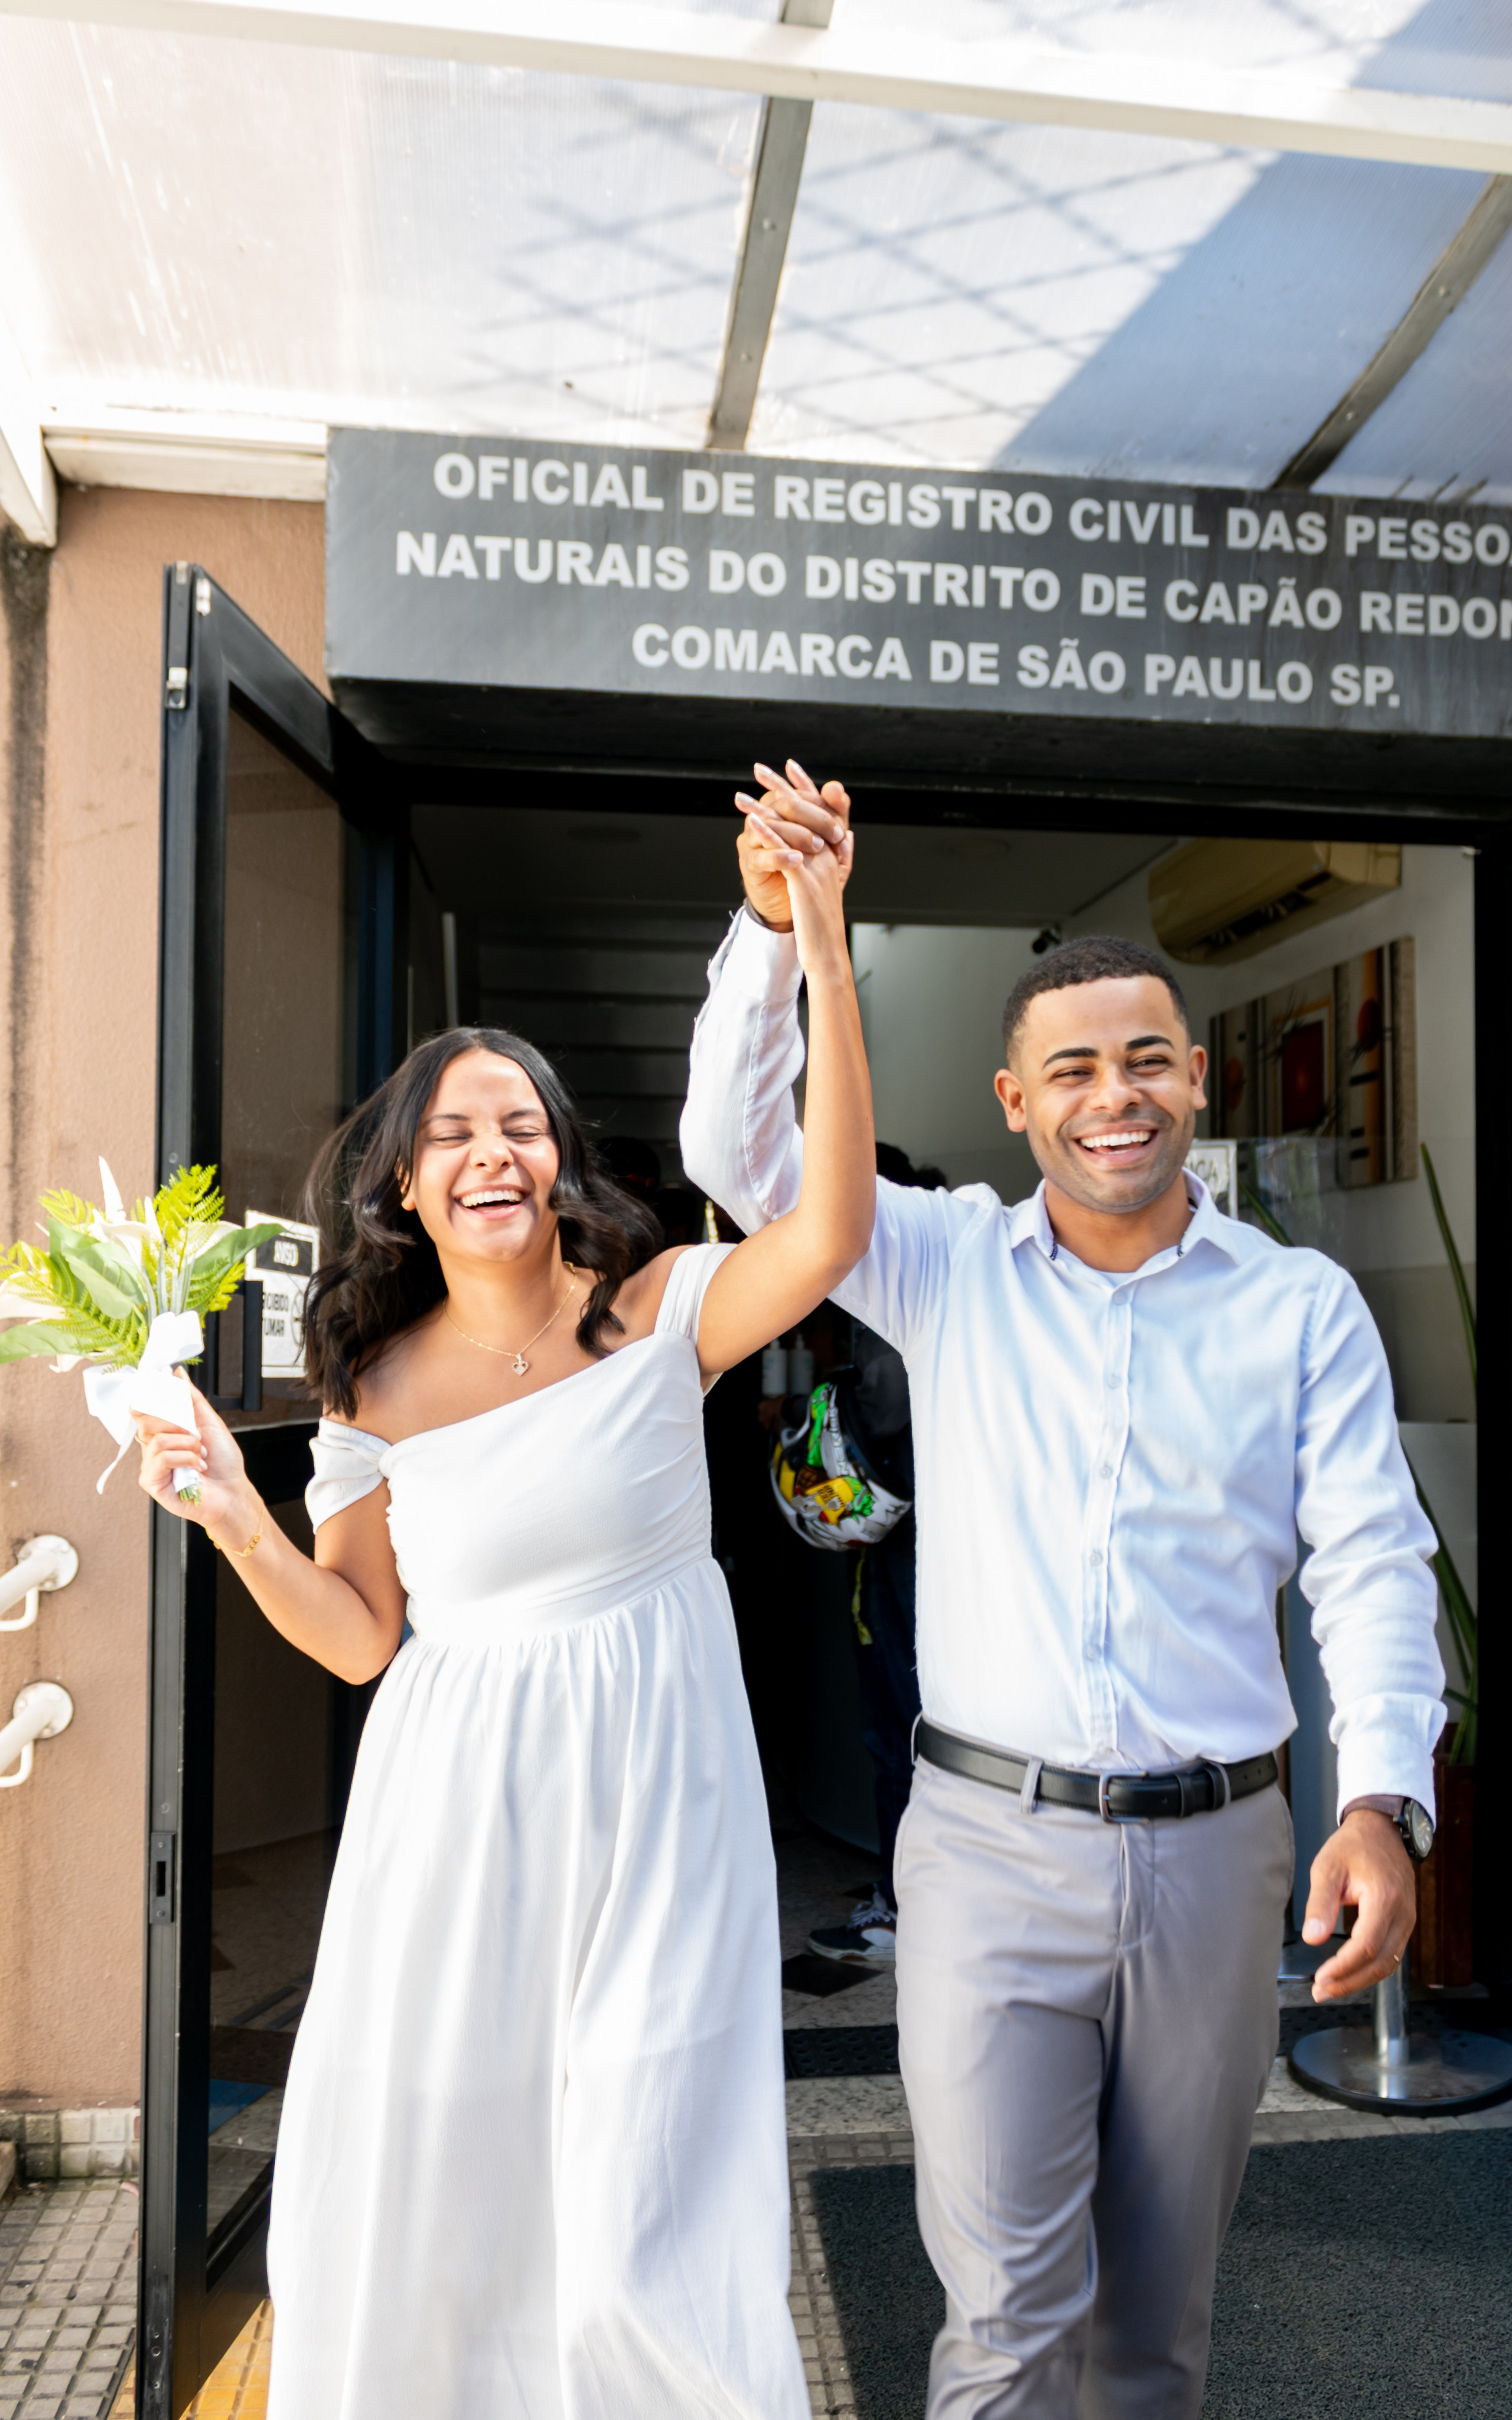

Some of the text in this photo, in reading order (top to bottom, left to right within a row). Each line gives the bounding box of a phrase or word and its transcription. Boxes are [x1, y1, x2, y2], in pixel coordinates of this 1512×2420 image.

[434, 453, 1512, 565] OFICIAL DE REGISTRO CIVIL DAS PESSO
[396, 531, 689, 590] NATURAIS
[709, 549, 787, 596] DO
[806, 555, 1061, 611] DISTRITO
[1080, 573, 1147, 619] DE
[1164, 577, 1342, 630] CAPÃO
[633, 624, 1400, 708] COMARCA DE SÃO PAULO SP.
[262, 1318, 285, 1337] UMAR
